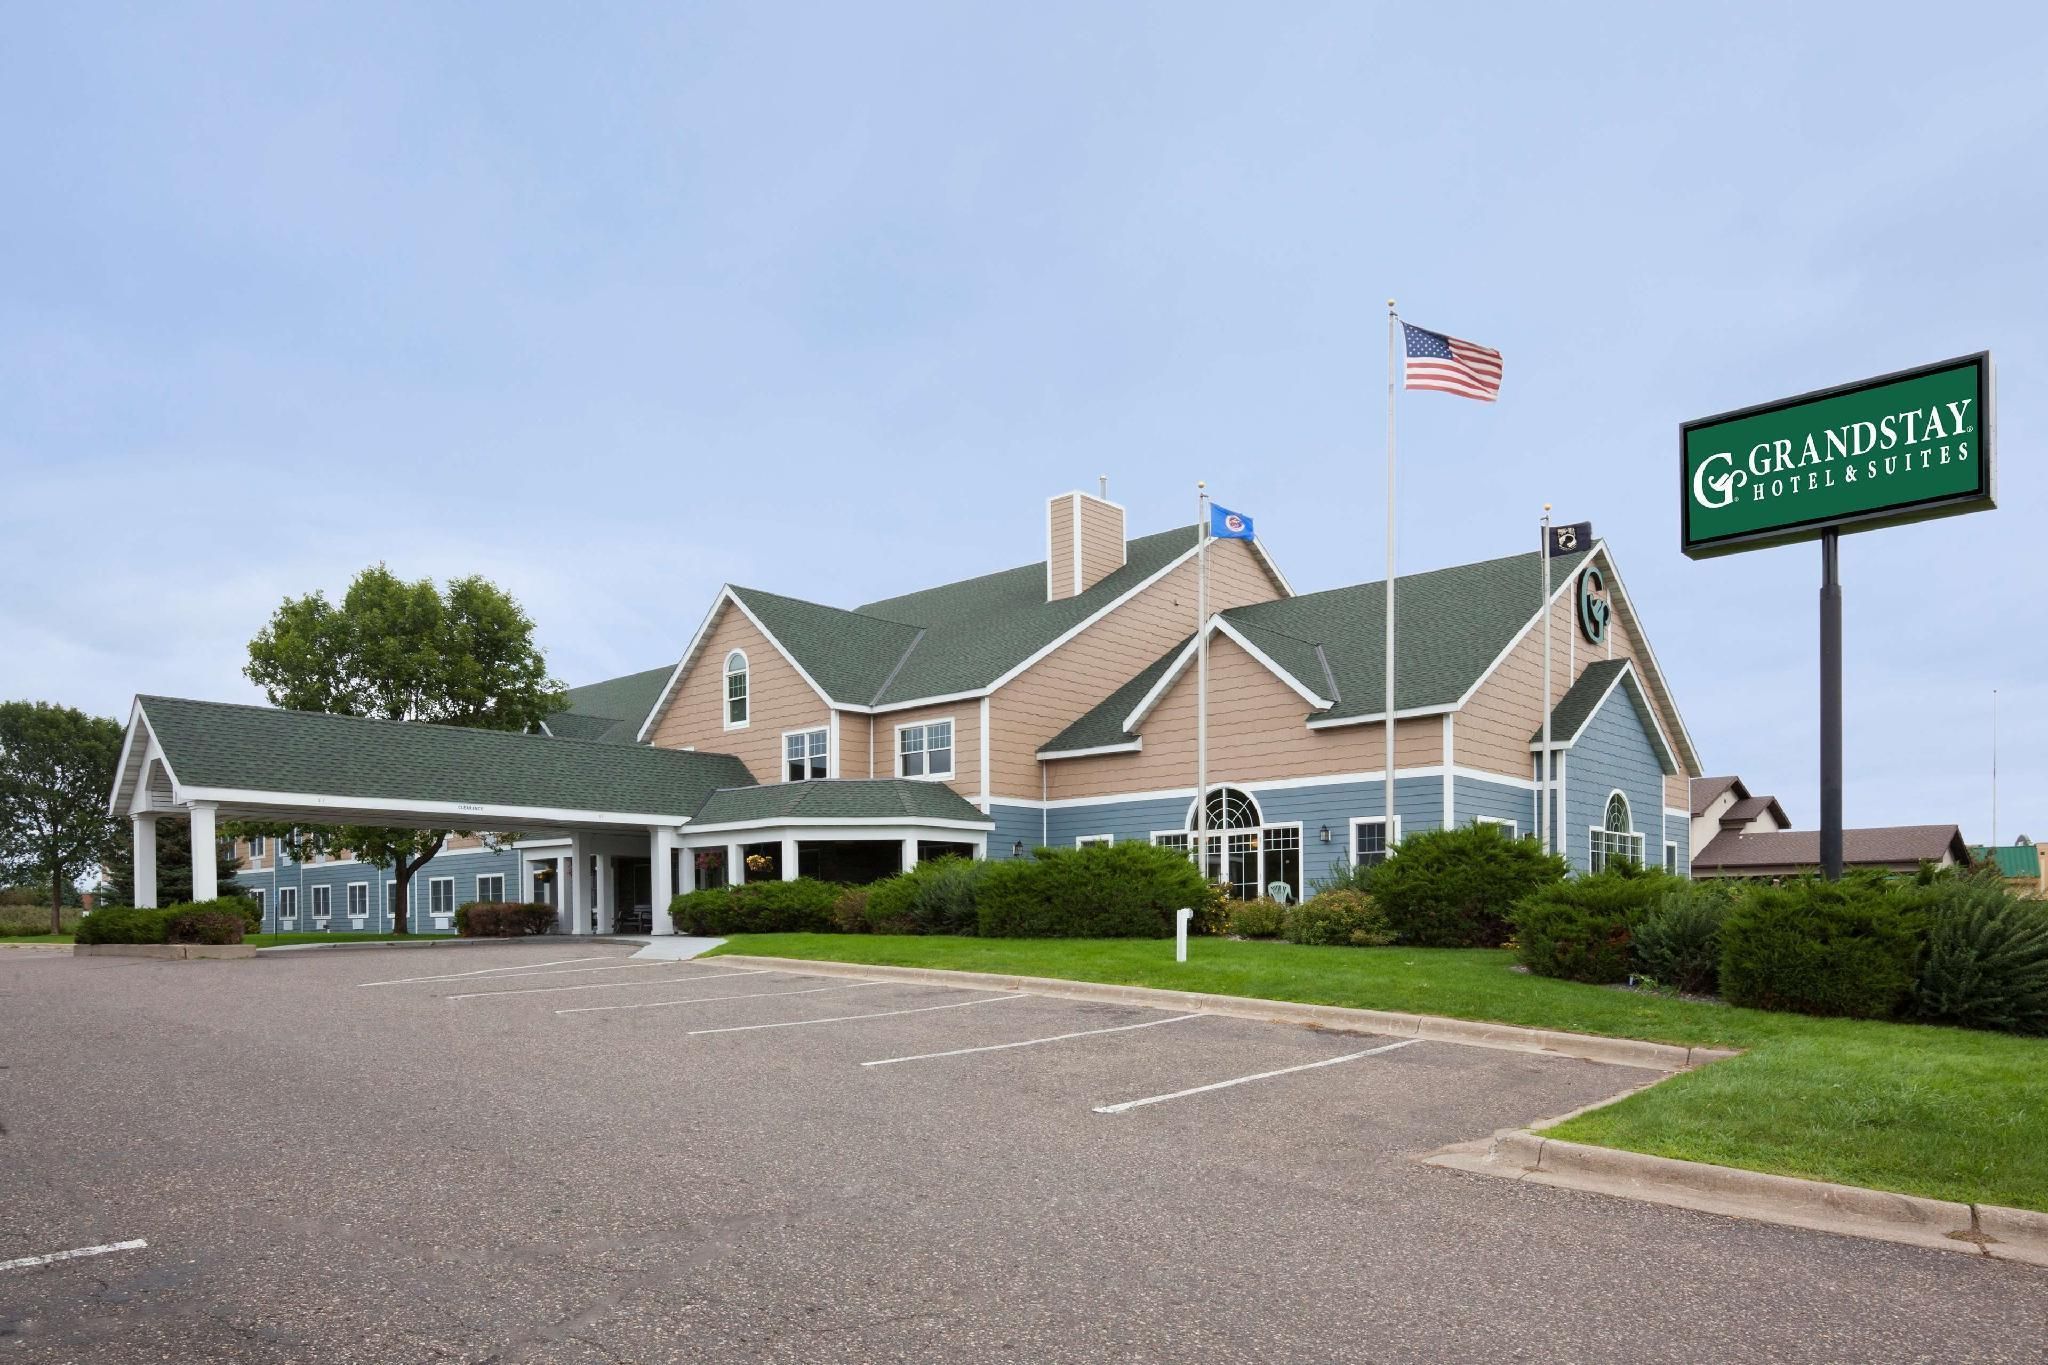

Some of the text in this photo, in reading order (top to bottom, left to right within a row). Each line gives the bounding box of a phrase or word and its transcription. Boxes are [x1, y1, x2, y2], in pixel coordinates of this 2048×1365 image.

[1749, 398, 1973, 476] GRANDSTAY
[1753, 442, 1969, 502] HOTEL & SUITES
